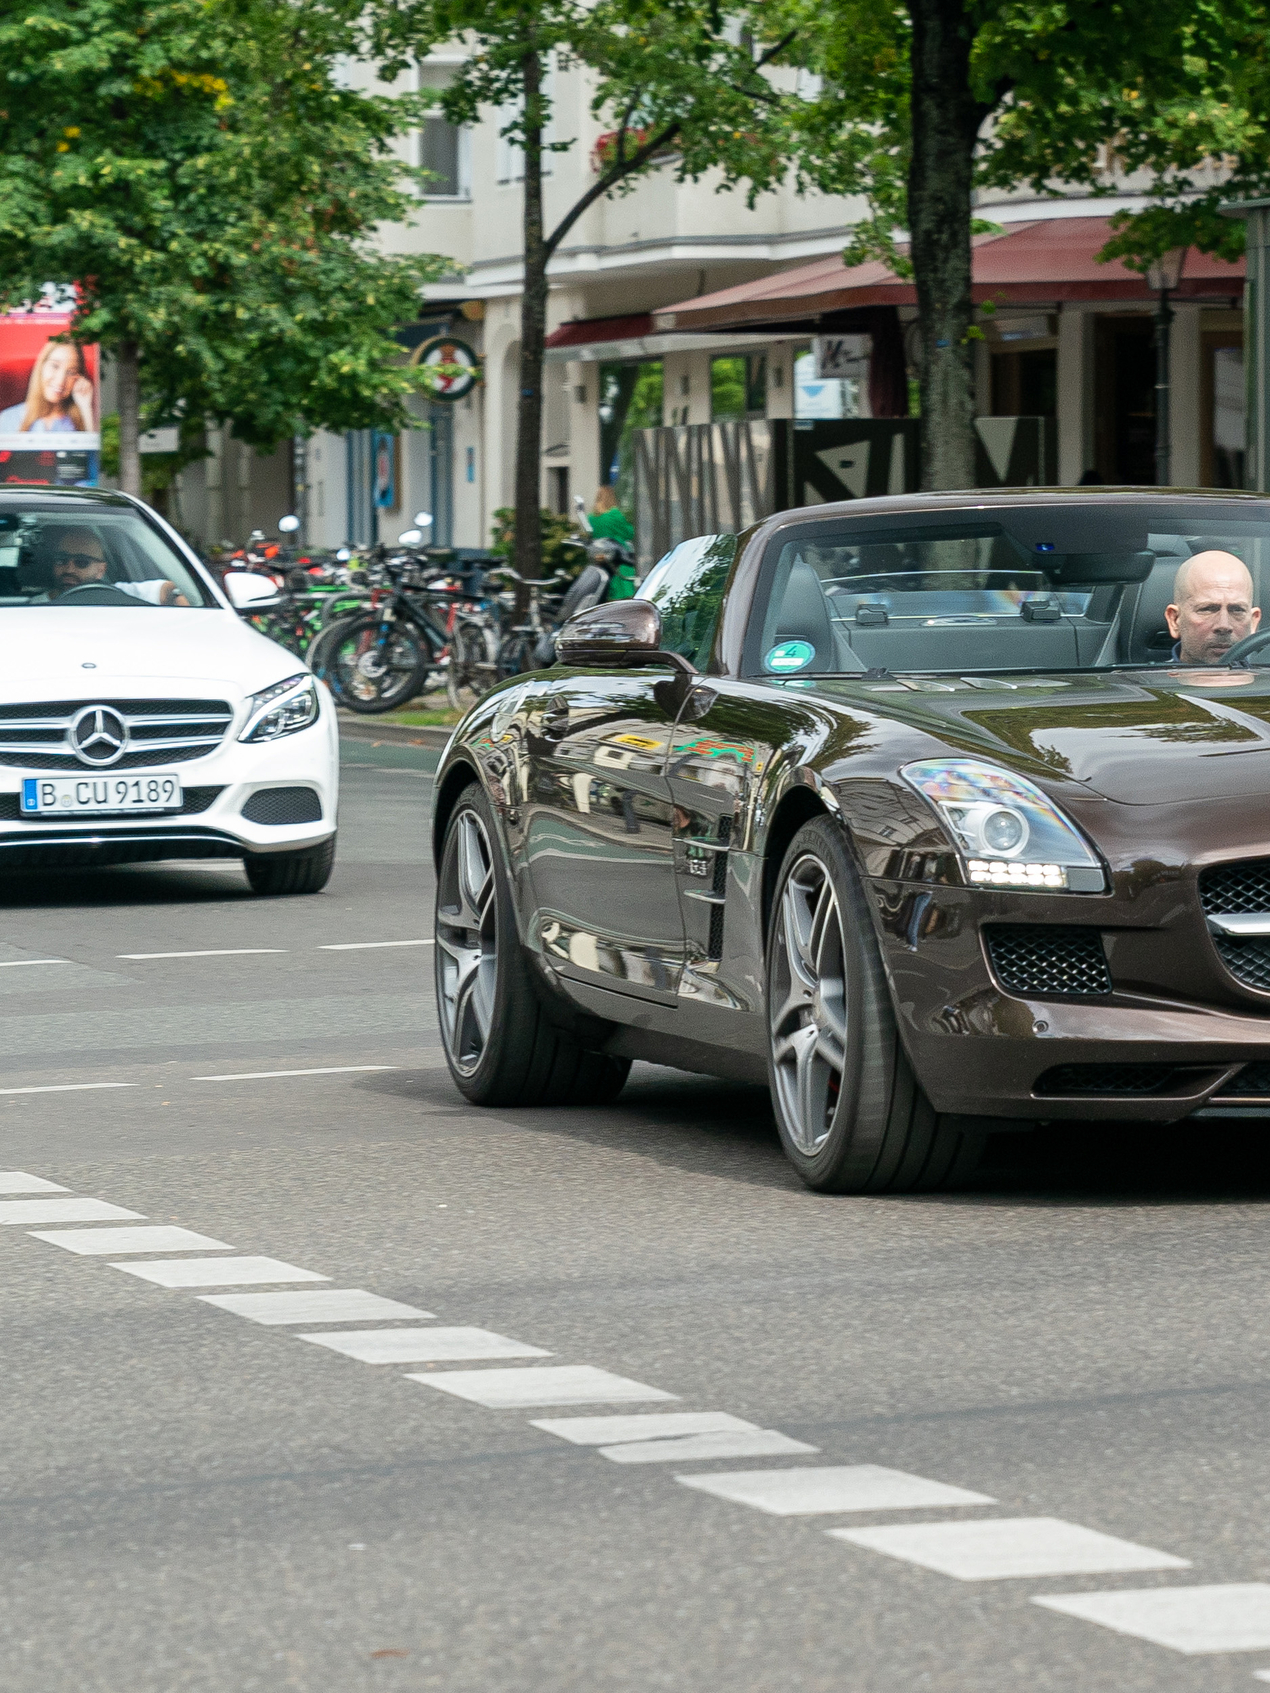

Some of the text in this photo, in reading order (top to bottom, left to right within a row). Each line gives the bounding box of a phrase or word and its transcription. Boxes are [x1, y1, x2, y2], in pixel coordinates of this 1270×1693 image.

[785, 645, 797, 657] 4
[41, 784, 56, 806] B
[76, 781, 107, 804] CU
[115, 779, 175, 803] 9189
